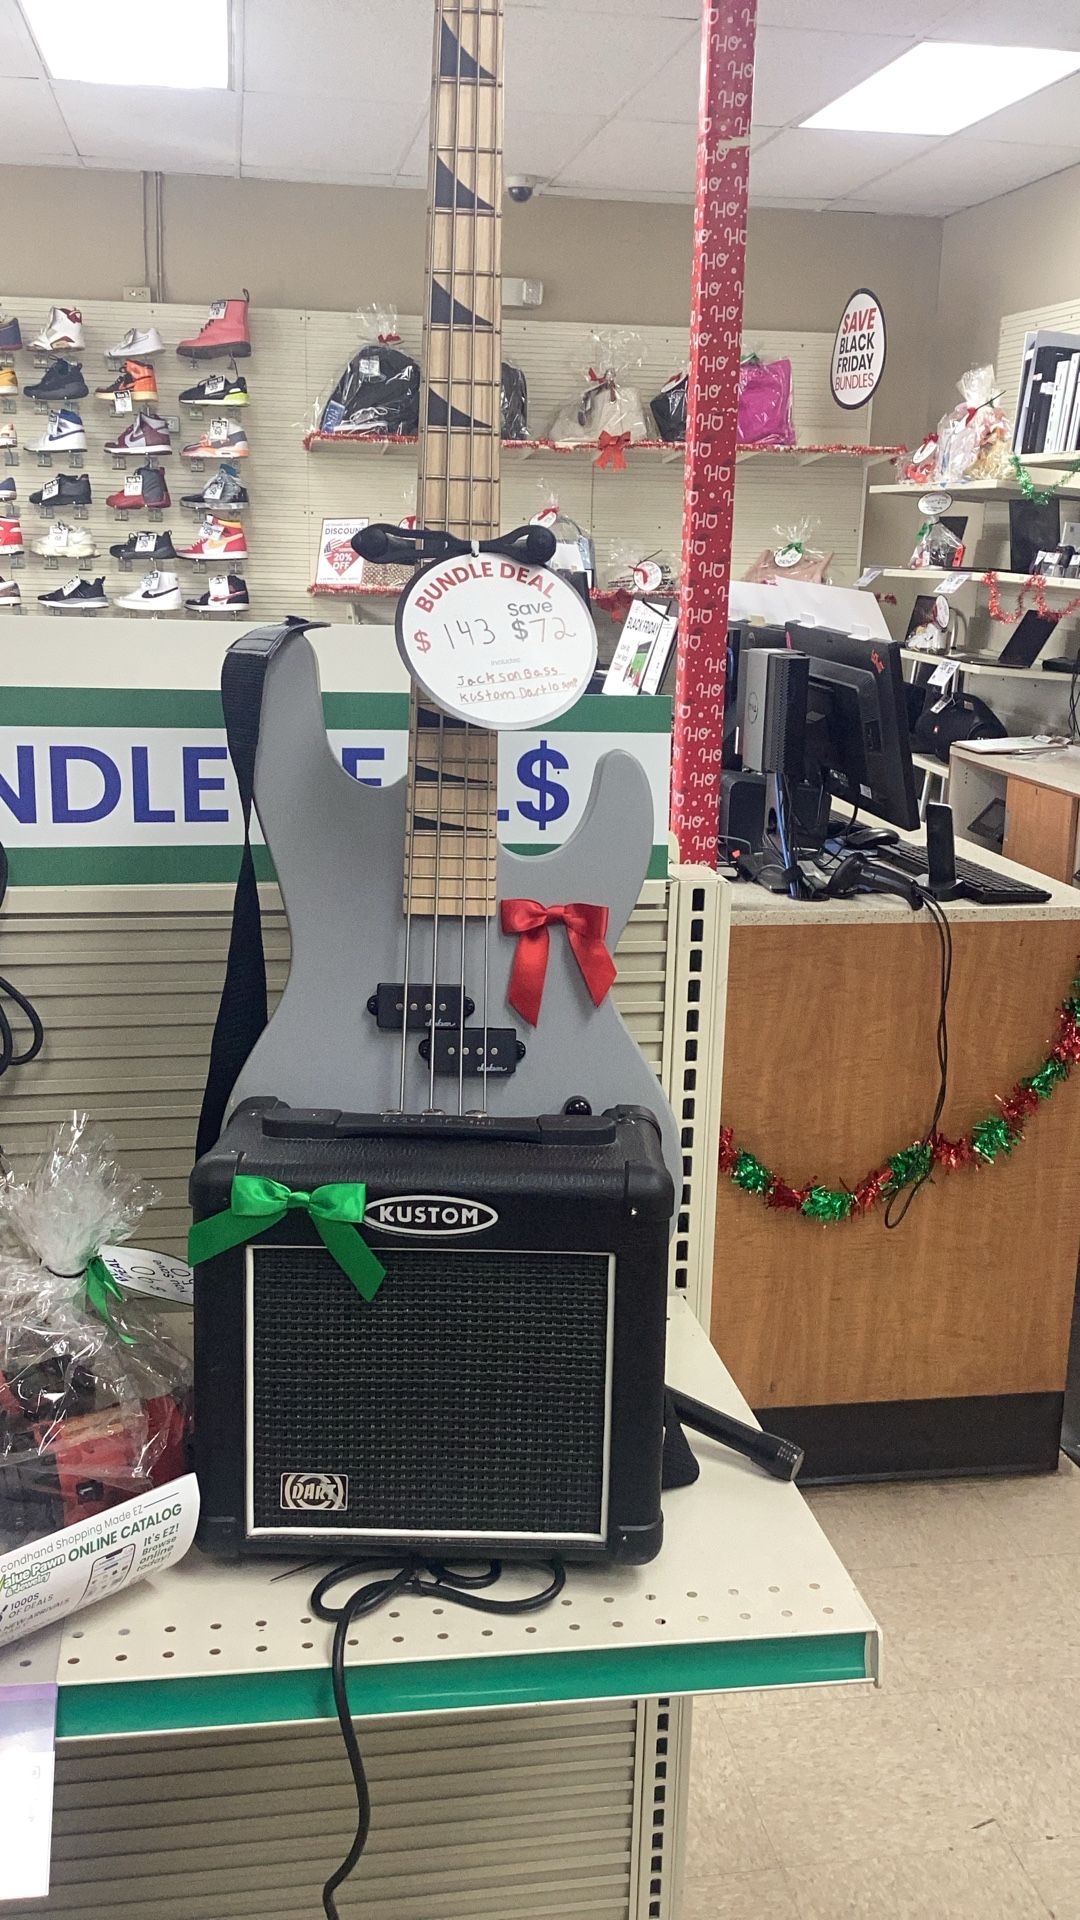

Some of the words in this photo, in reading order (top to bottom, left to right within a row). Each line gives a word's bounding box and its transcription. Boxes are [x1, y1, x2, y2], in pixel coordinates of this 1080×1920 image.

[711, 34, 742, 53] HO
[718, 90, 748, 108] HO
[710, 201, 739, 218] HO
[700, 253, 729, 270] HO
[697, 281, 722, 299] HO
[710, 306, 739, 322] HO
[842, 308, 877, 335] SAVE
[840, 332, 875, 355] BLACK
[700, 355, 729, 373] HO
[836, 353, 874, 374] FRIDAY
[835, 373, 874, 391] BUNDLES
[694, 384, 721, 401] HO
[333, 561, 350, 570] OFF
[334, 553, 352, 561] 20%
[414, 562, 494, 613] BUNDLE
[500, 562, 556, 598] DEAL
[507, 601, 553, 617] Save
[457, 671, 521, 686] Jackson
[696, 683, 723, 699] HO
[684, 727, 711, 743] HO
[690, 773, 717, 788] HO
[678, 815, 704, 830] HO
[692, 836, 718, 851] HO
[379, 1206, 479, 1225] KUSTOM
[56, 1523, 102, 1549] Shopping
[104, 1511, 131, 1528] Made
[133, 1504, 143, 1517] EZ
[144, 1533, 160, 1547] It's
[162, 1523, 179, 1538] EZ!
[31, 1554, 66, 1578] Pawn
[68, 1531, 117, 1562] ONLINE
[121, 1503, 182, 1539] CATALOG
[142, 1536, 176, 1556] Browse
[140, 1545, 174, 1564] online
